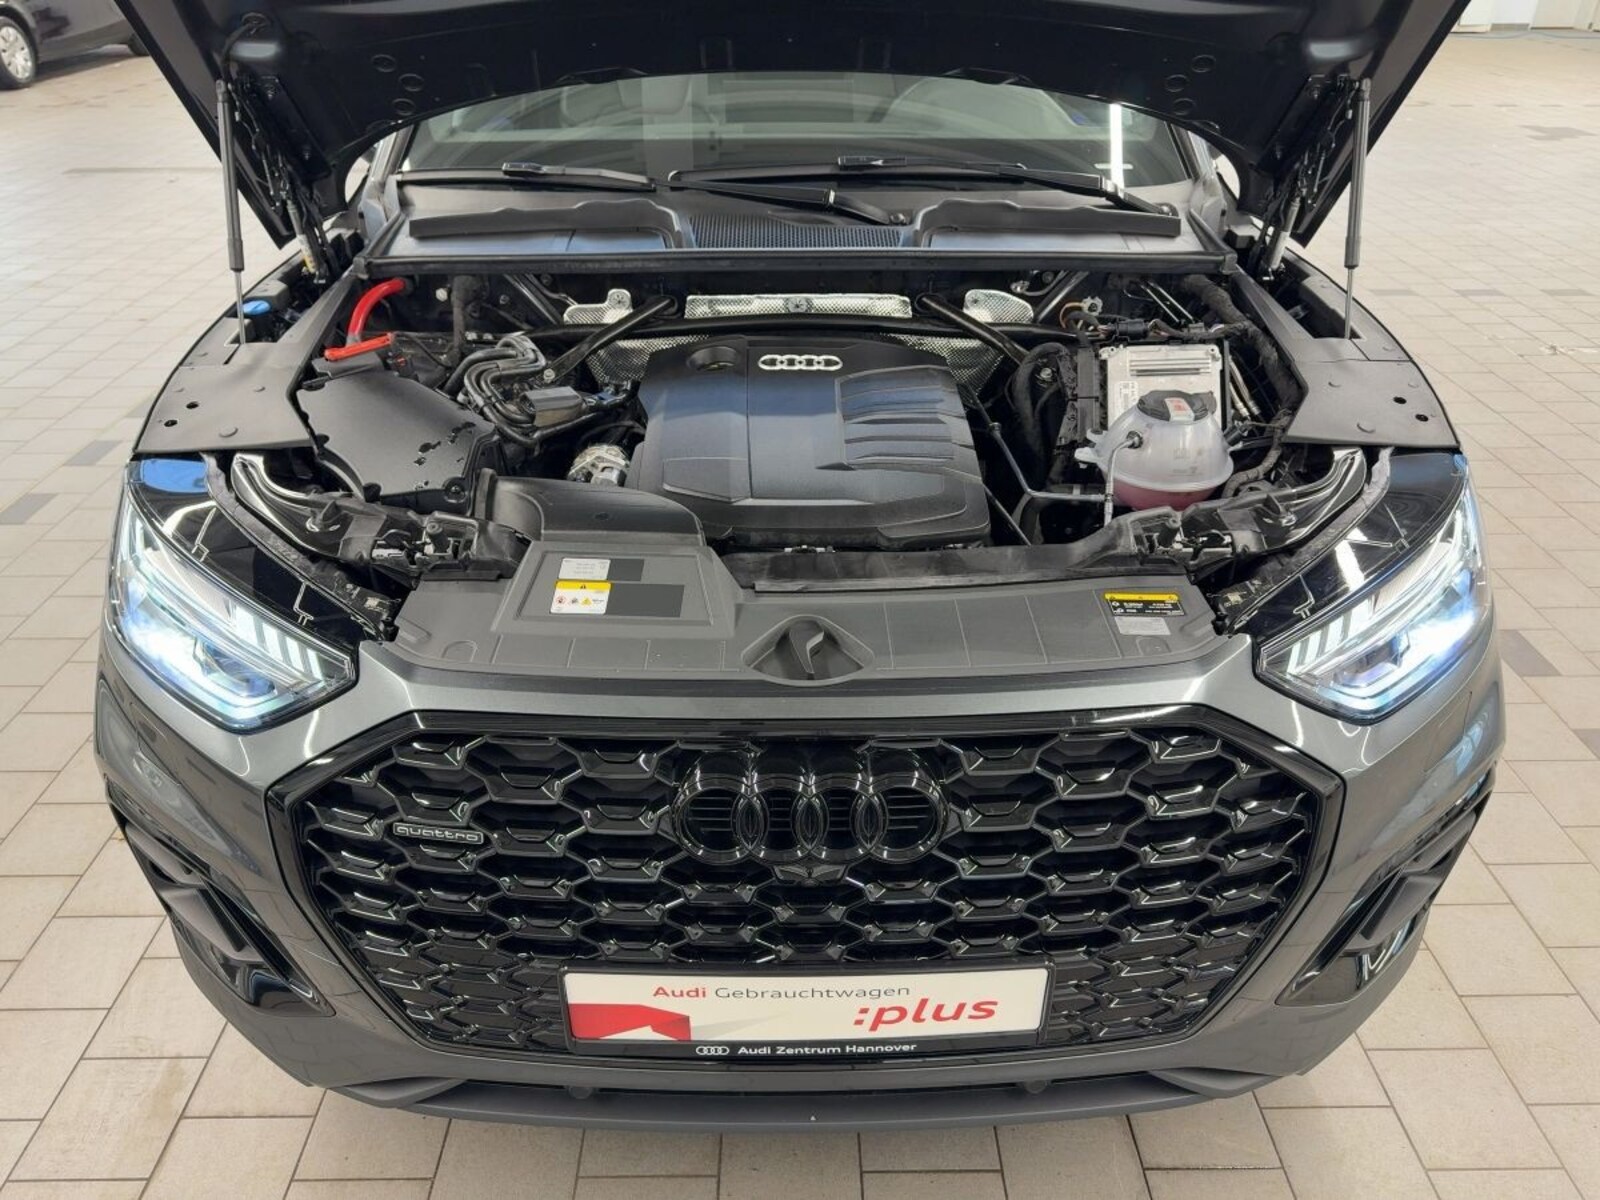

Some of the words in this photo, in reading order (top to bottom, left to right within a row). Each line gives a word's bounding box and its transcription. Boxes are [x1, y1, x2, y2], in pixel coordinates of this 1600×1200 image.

[396, 826, 479, 841] quattro
[652, 985, 707, 998] Audi
[714, 985, 910, 999] Gebrauchtwagen
[738, 1045, 772, 1055] Audi
[775, 1044, 842, 1055] Zentrum
[845, 1042, 917, 1054] Hannover
